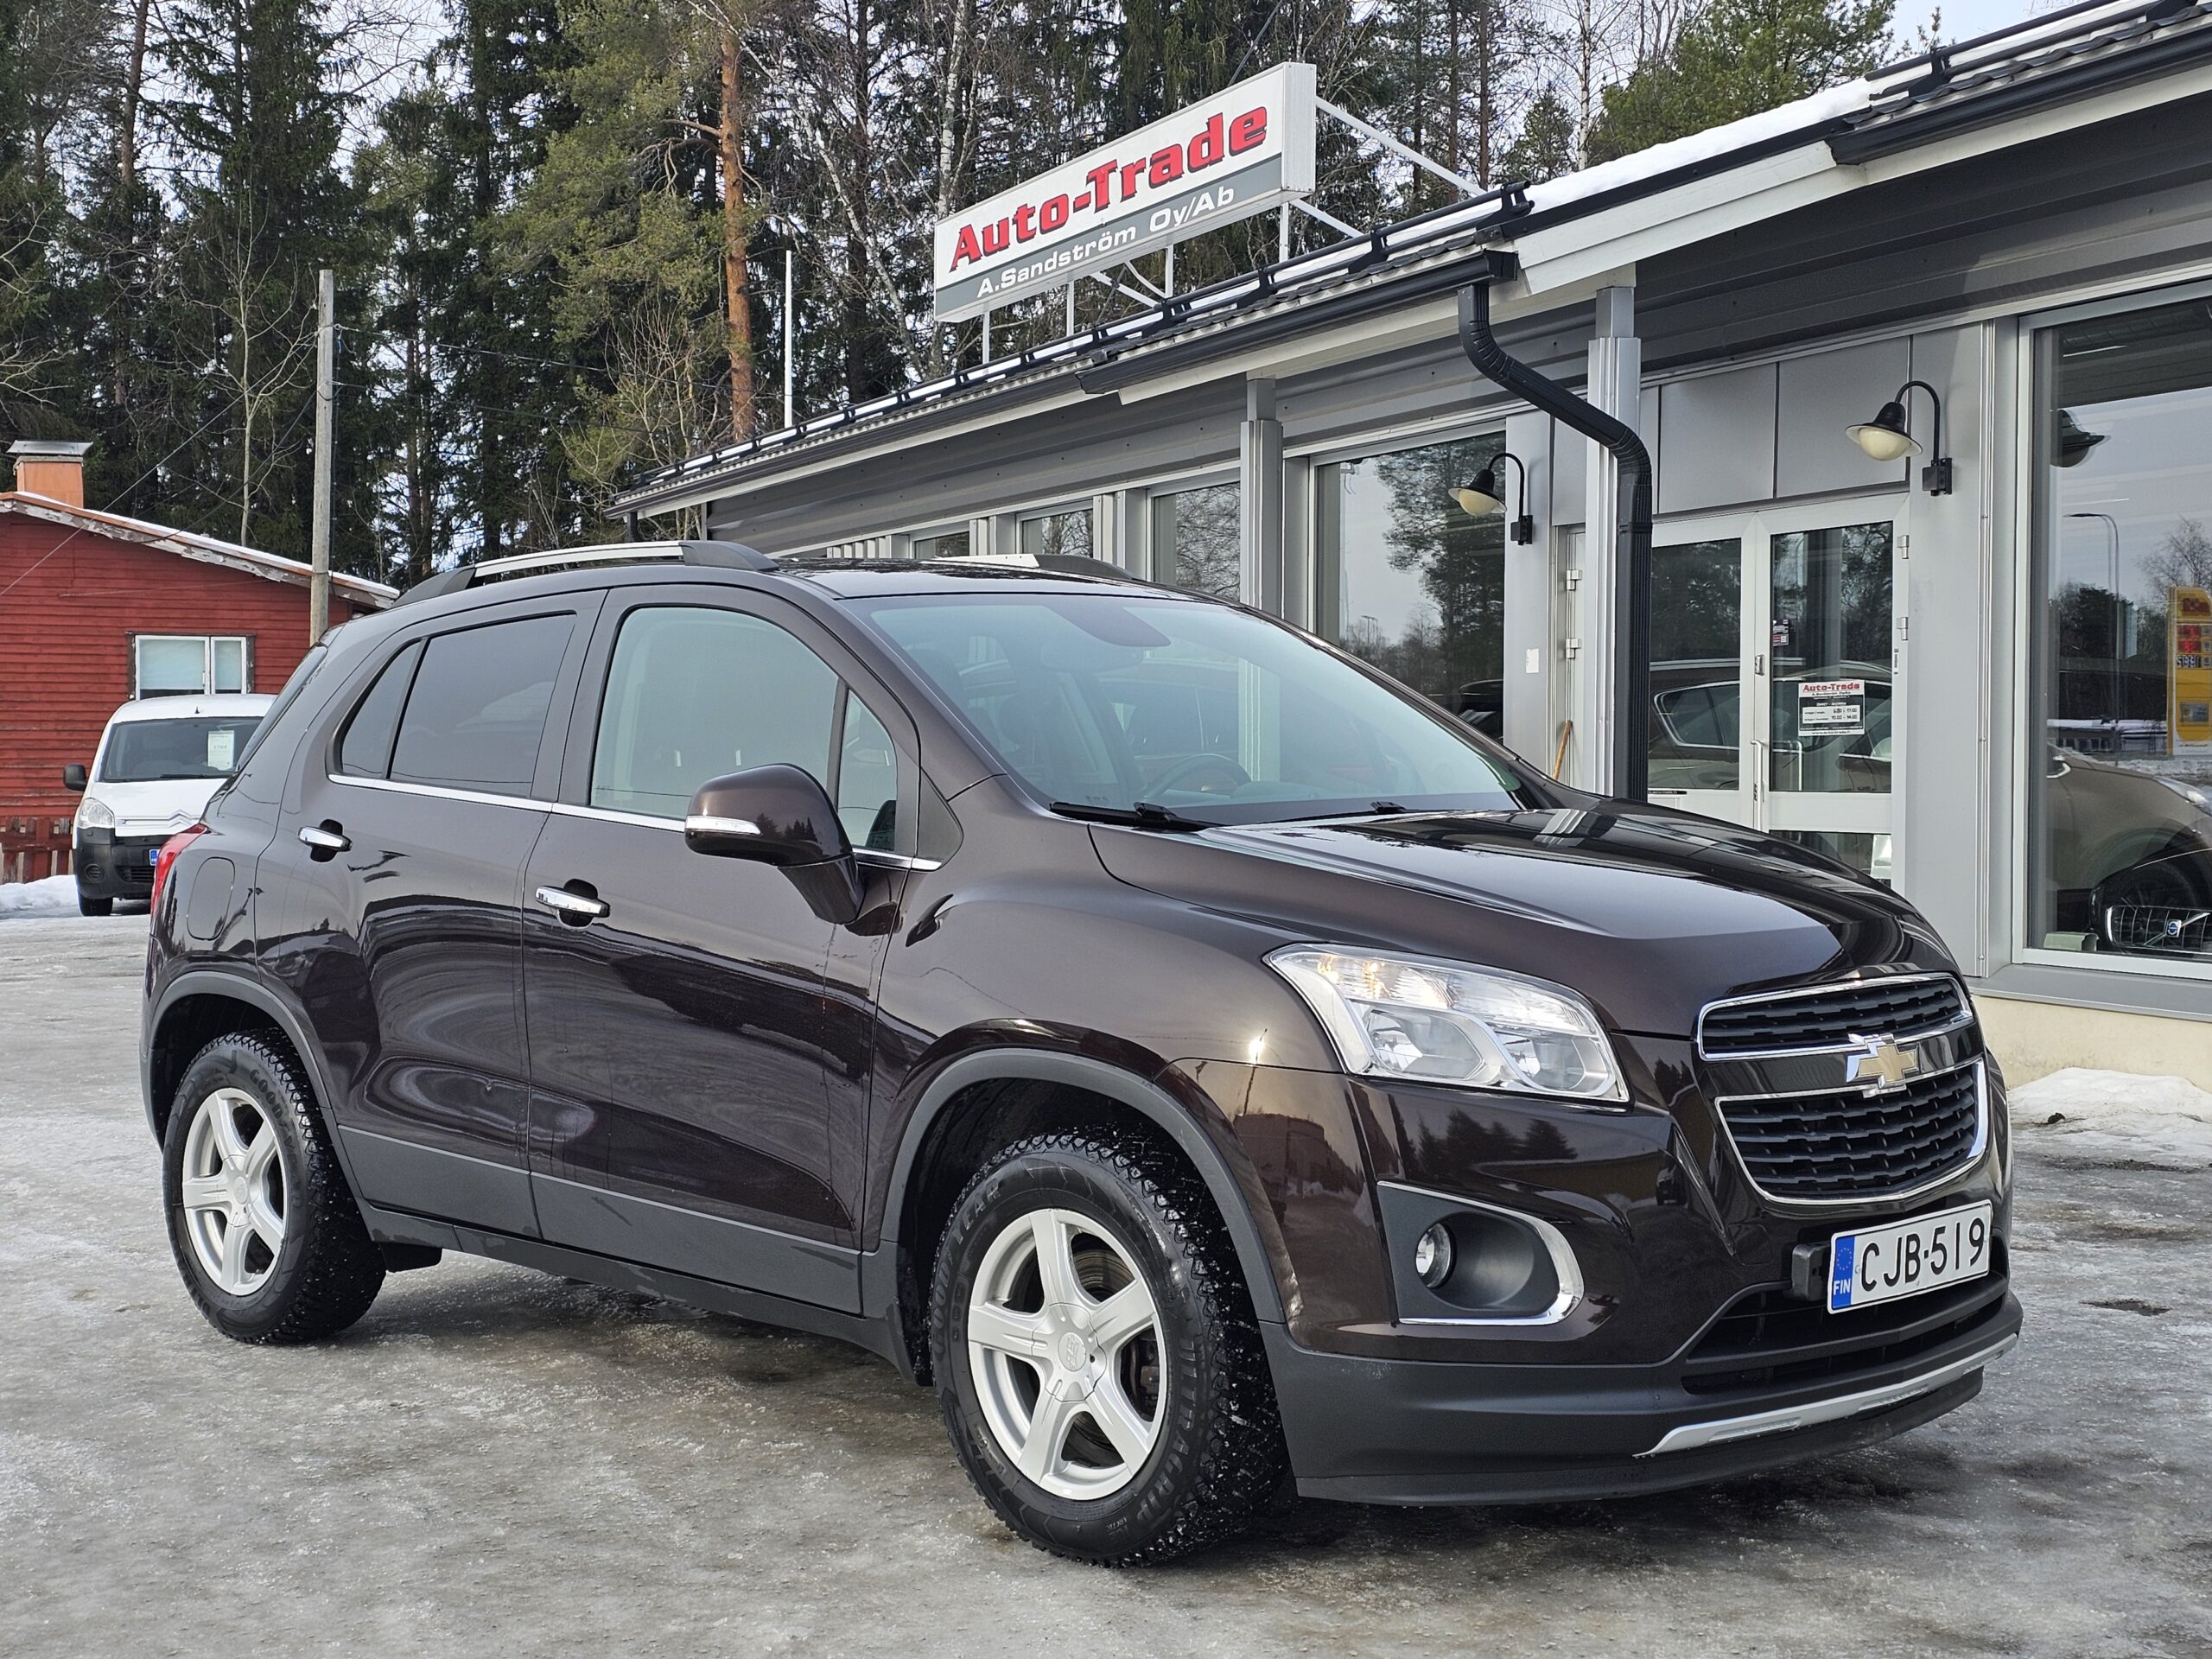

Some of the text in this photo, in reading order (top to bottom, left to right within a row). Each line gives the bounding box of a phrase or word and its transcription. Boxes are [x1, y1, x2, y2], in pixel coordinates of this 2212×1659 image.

[949, 105, 1268, 273] Auto-Trade
[976, 184, 1234, 298] A.Sandström Oy/Ab
[1802, 683, 1860, 691] Auto-Trade
[1833, 1217, 1985, 1296] FIN CJB-519
